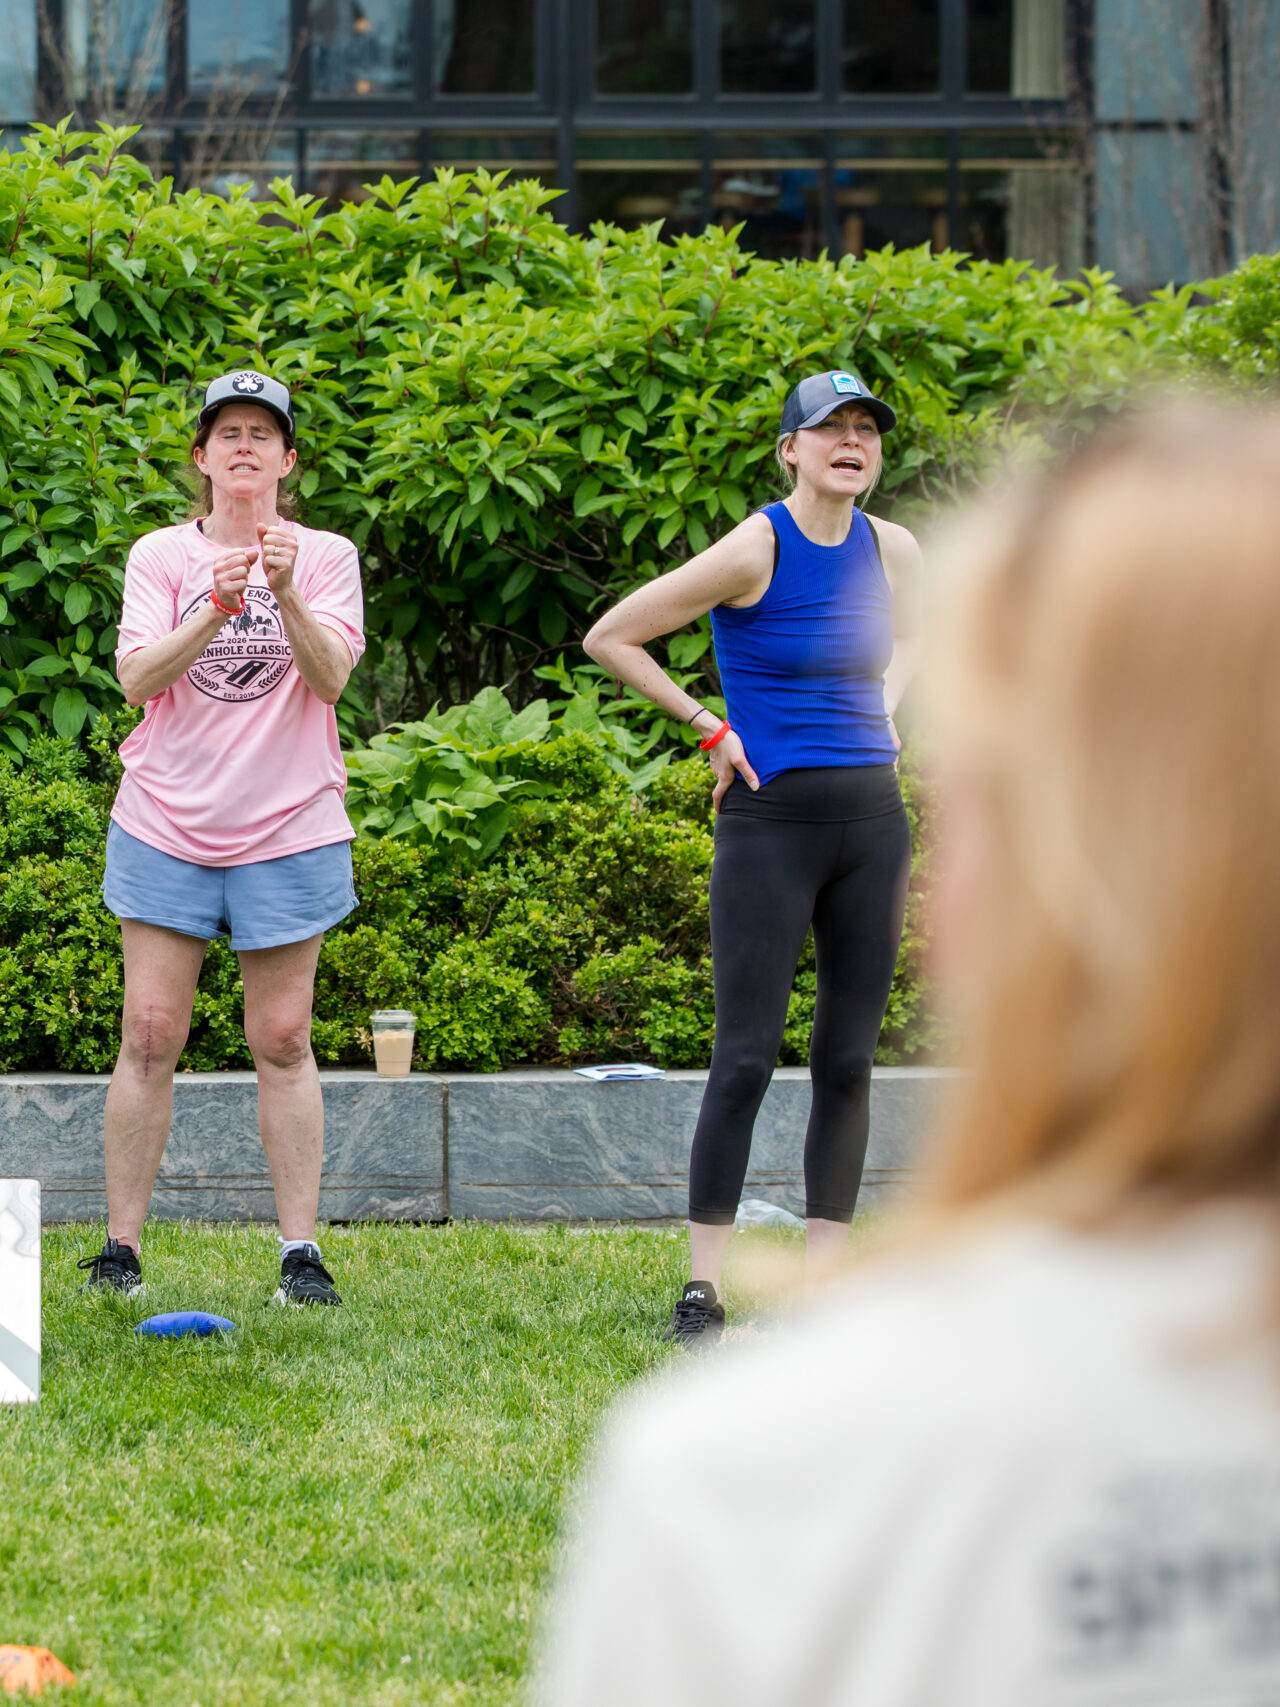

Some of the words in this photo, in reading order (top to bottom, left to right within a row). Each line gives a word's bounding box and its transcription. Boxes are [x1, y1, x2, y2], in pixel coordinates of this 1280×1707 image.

[247, 589, 271, 602] END
[199, 645, 244, 659] RNHOLE
[246, 645, 291, 656] CLASSIC
[239, 691, 255, 699] 2016
